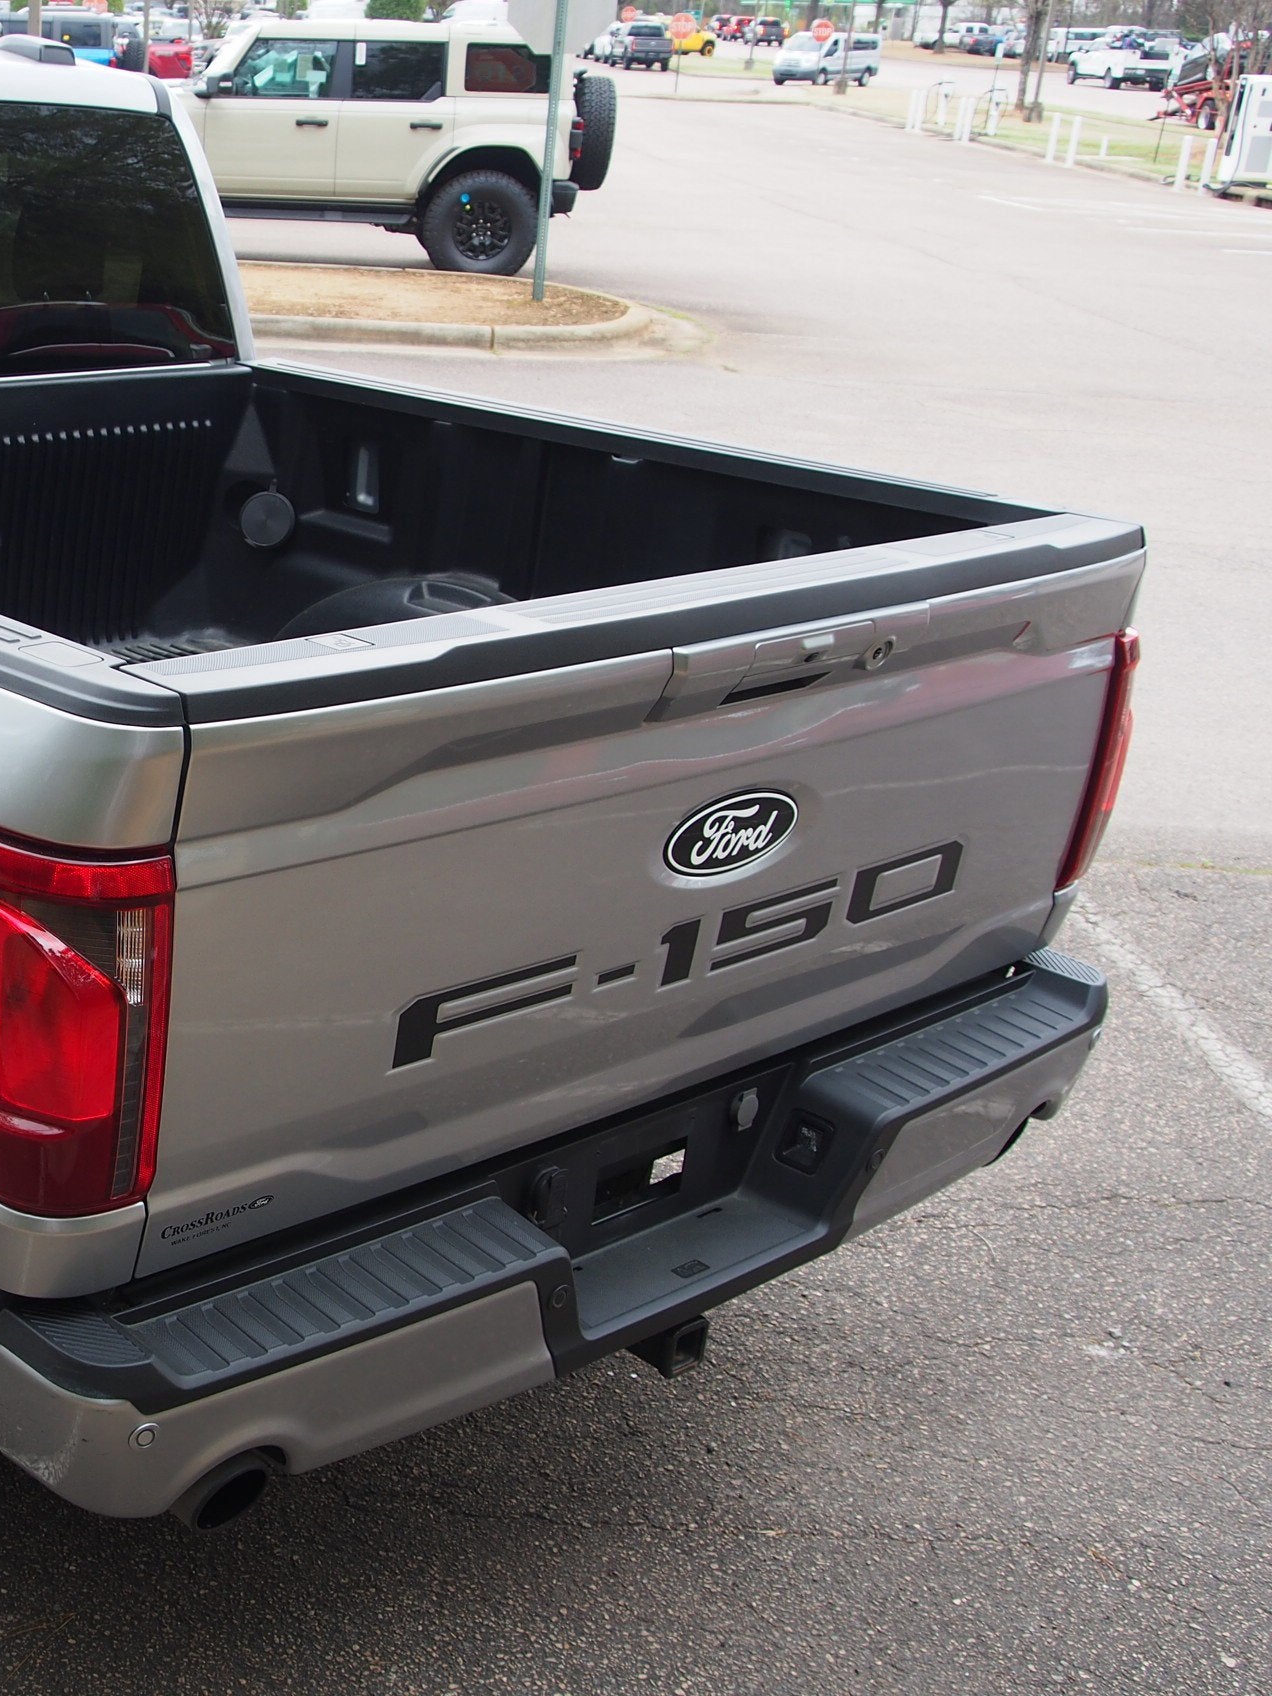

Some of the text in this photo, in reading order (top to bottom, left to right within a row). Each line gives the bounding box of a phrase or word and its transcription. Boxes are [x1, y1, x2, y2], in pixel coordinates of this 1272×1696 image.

[813, 28, 831, 36] STOP
[690, 804, 778, 865] Ford
[391, 840, 964, 1069] F-150
